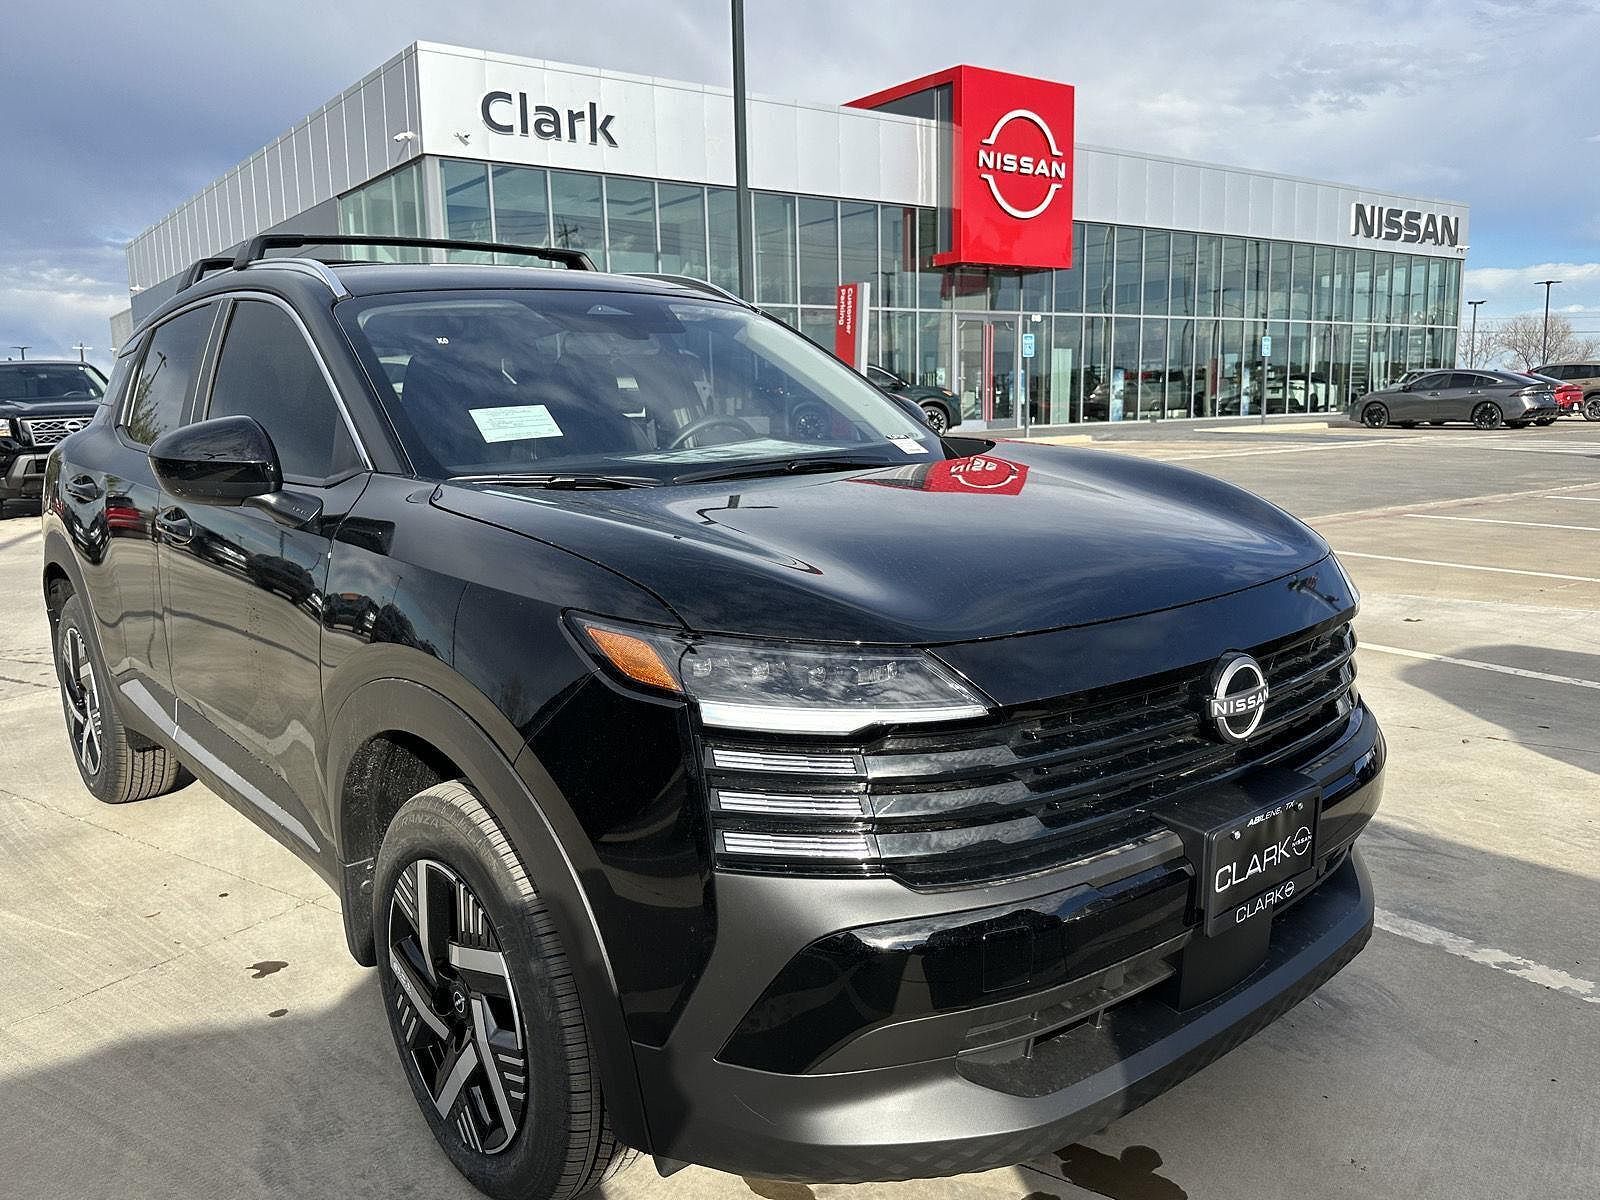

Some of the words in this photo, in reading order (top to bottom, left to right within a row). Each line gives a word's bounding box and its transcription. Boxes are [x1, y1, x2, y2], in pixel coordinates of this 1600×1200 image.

[481, 90, 619, 148] Clark
[978, 149, 1066, 179] NISSAN
[1350, 202, 1460, 247] NISSAN
[1213, 679, 1269, 716] NISSAN
[1285, 800, 1295, 810] TX
[1215, 835, 1291, 893] CLARK
[1236, 885, 1285, 923] CLARK
